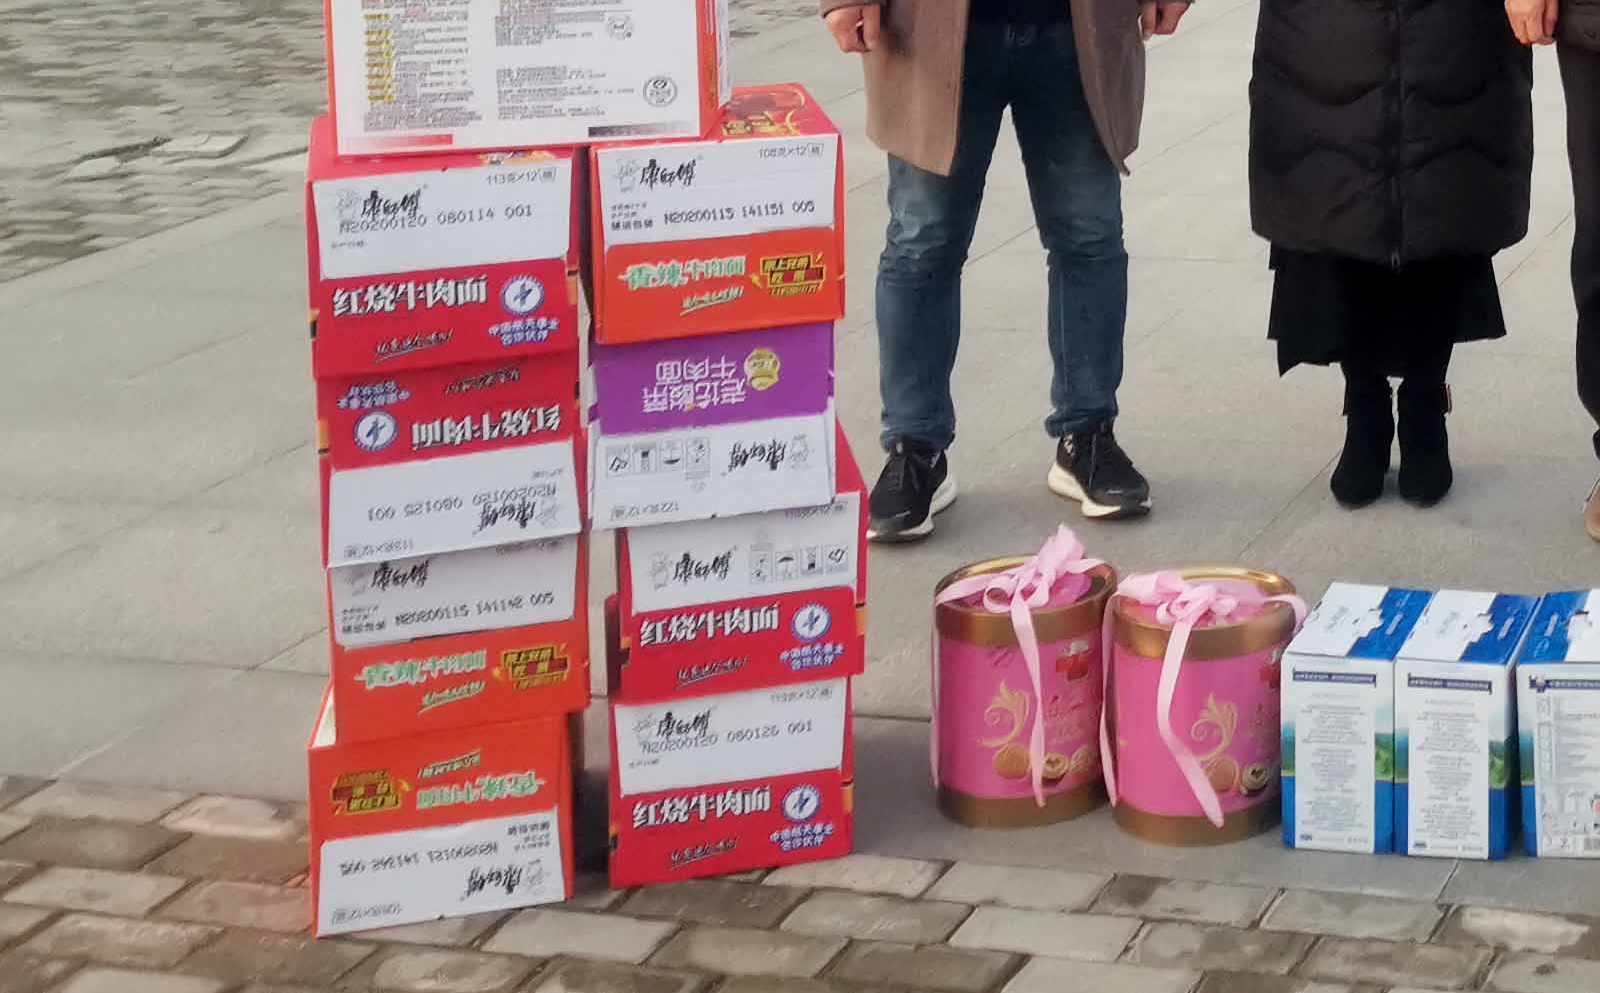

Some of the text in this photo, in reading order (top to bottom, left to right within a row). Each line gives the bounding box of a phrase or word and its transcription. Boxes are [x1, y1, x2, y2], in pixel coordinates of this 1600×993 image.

[626, 255, 746, 289] 香辣牛肉面
[333, 275, 489, 318] 红烧牛肉面
[655, 356, 737, 384] 牛肉面
[641, 377, 747, 413] 老坛酸菜
[411, 404, 561, 450] 红烧牛肉面
[639, 603, 780, 647] 红烧牛肉面
[632, 785, 773, 829] 红烧牛肉面
